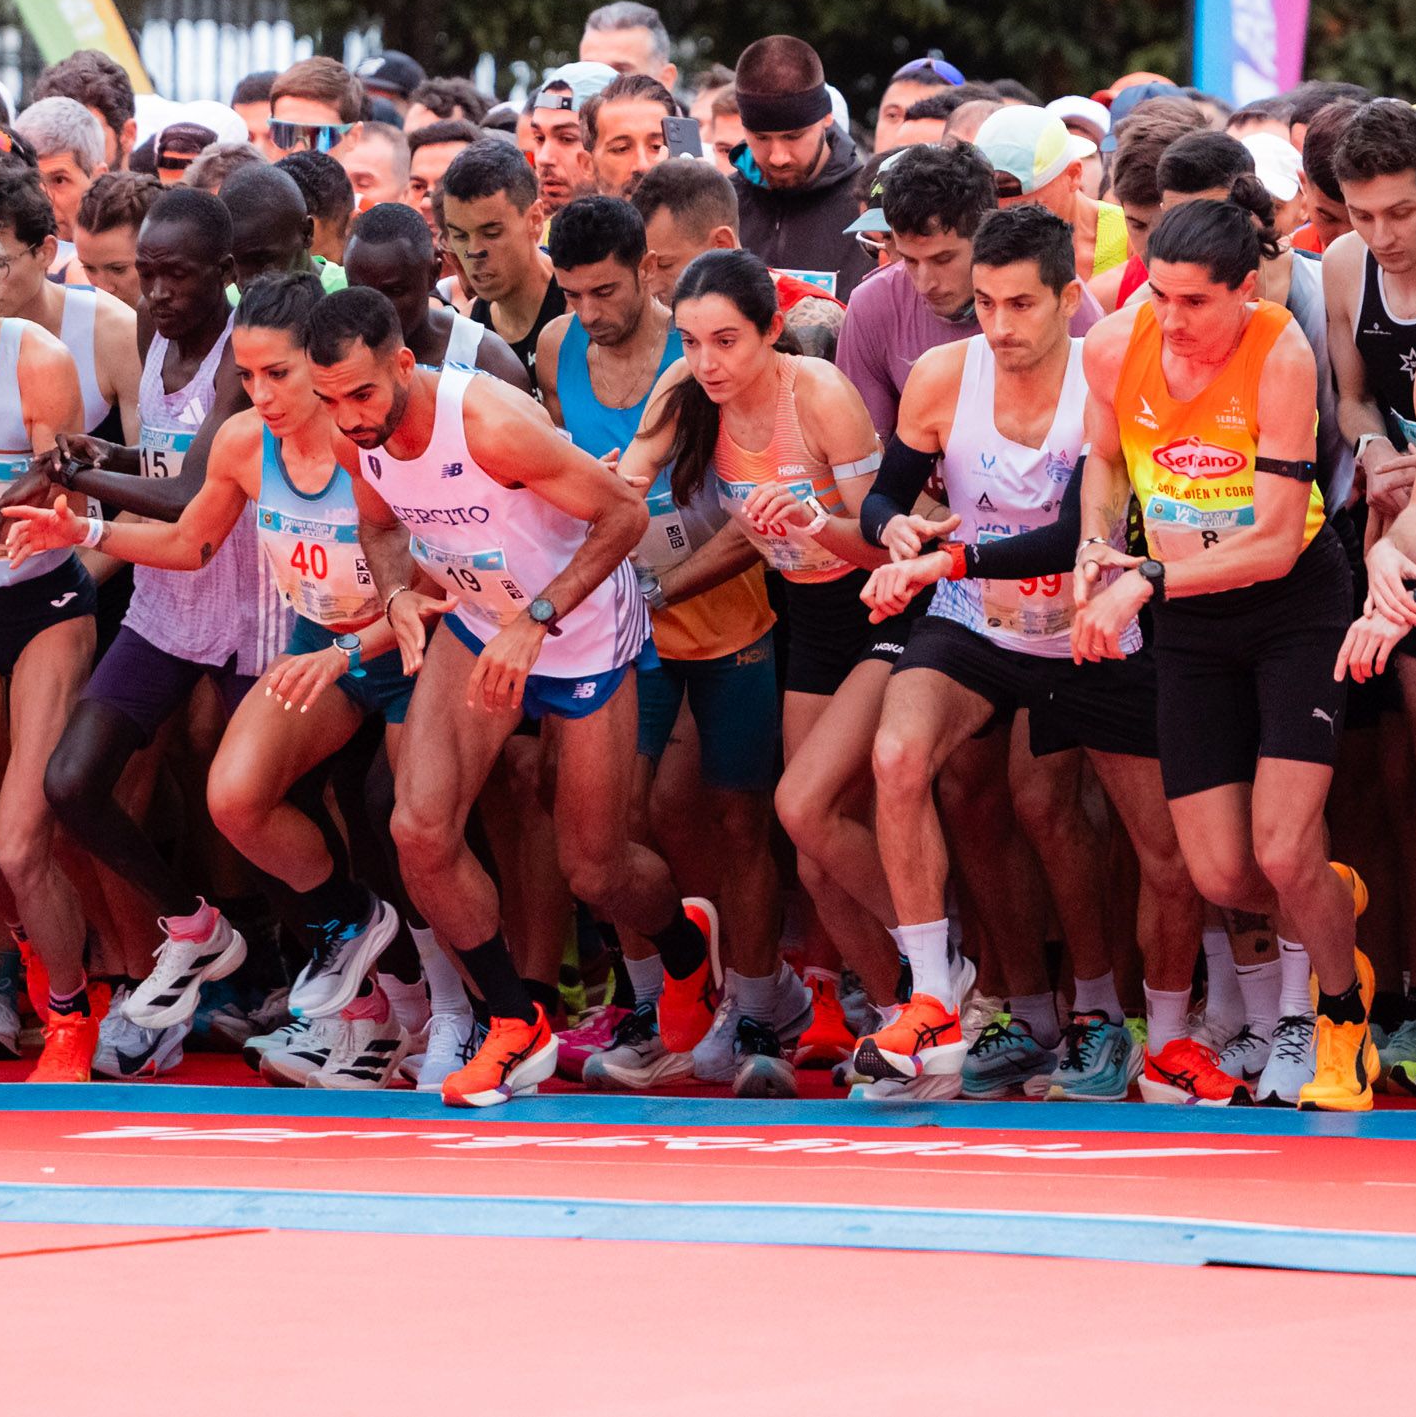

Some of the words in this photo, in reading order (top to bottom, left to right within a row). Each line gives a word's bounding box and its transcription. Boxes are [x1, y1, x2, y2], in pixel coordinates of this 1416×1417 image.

[777, 464, 806, 476] HOKA
[1214, 485, 1221, 498] Y
[290, 541, 328, 580] 40
[446, 565, 481, 593] 19
[872, 641, 905, 655] HOKA
